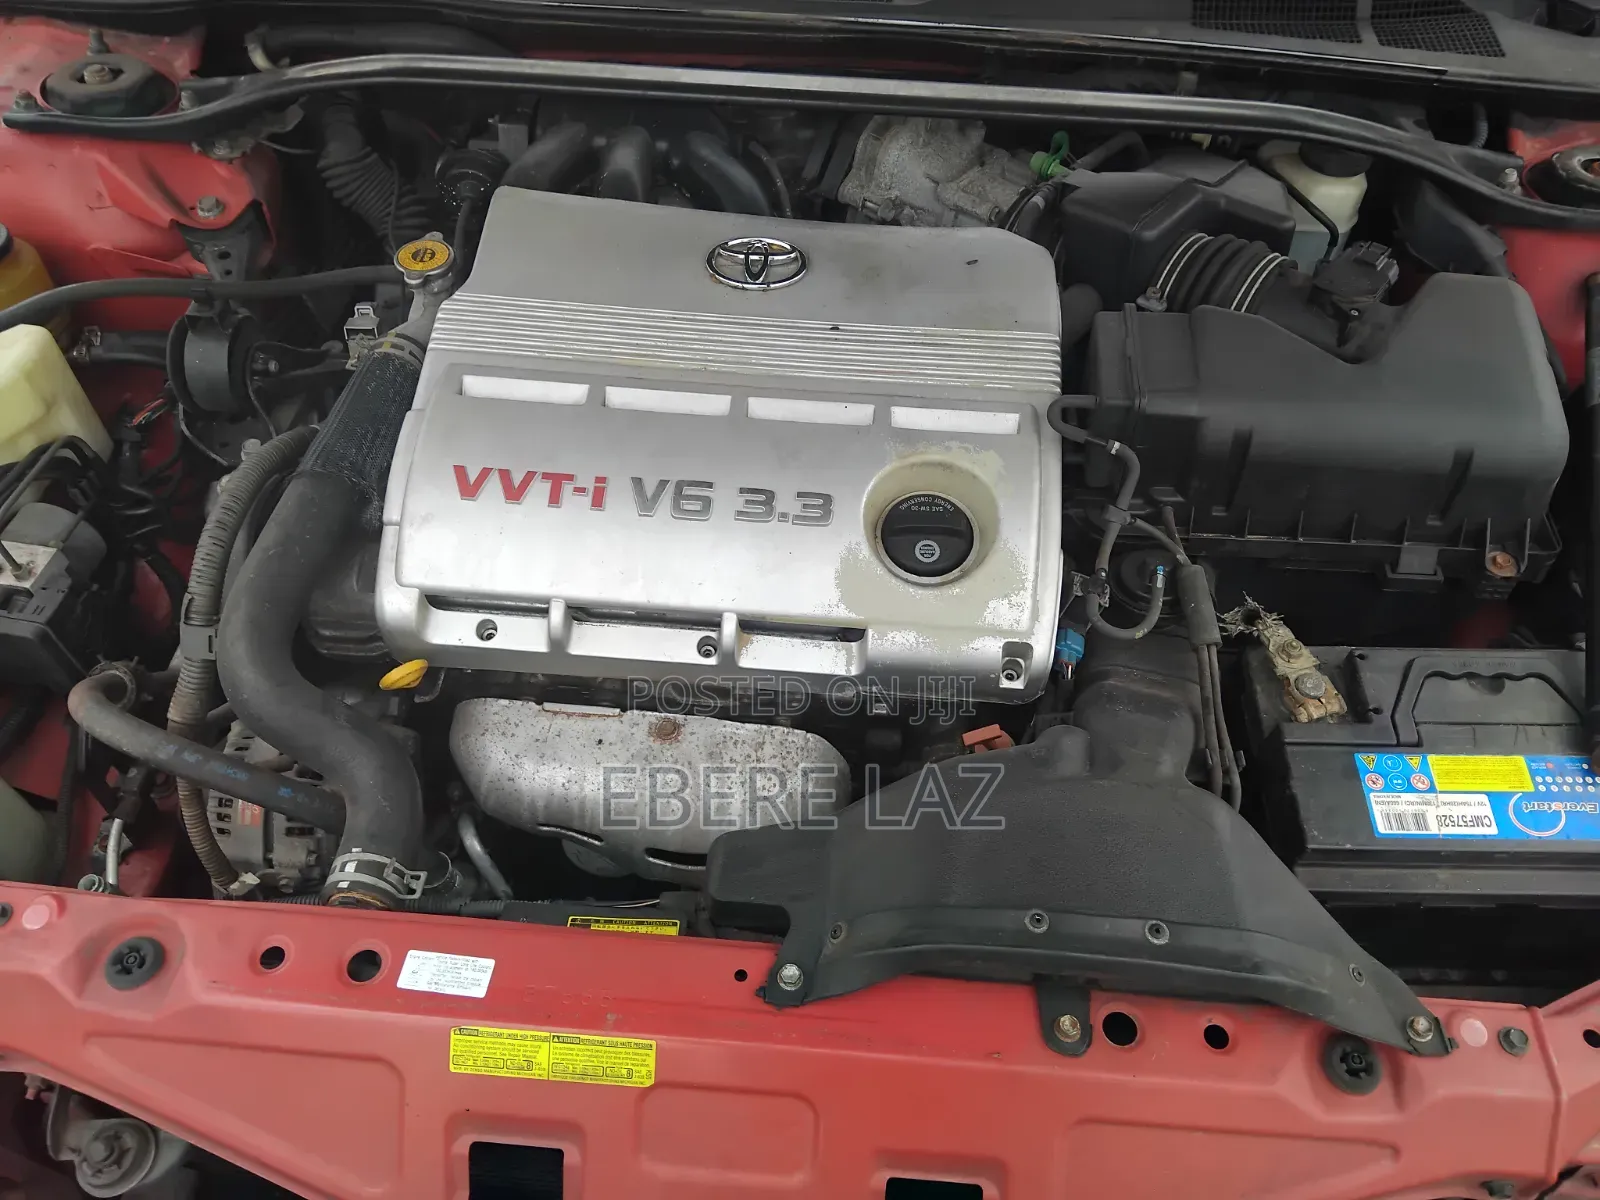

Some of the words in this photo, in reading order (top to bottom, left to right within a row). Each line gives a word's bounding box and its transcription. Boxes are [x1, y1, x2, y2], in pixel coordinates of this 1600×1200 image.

[452, 464, 608, 511] VVT-i
[630, 476, 715, 521] V6
[734, 487, 834, 527] 3.3
[900, 496, 932, 510] CONSERVING
[934, 498, 954, 512] ENERGY
[1522, 801, 1599, 813] Everstart
[1435, 814, 1492, 828] CMF57528
[527, 1061, 531, 1069] 8
